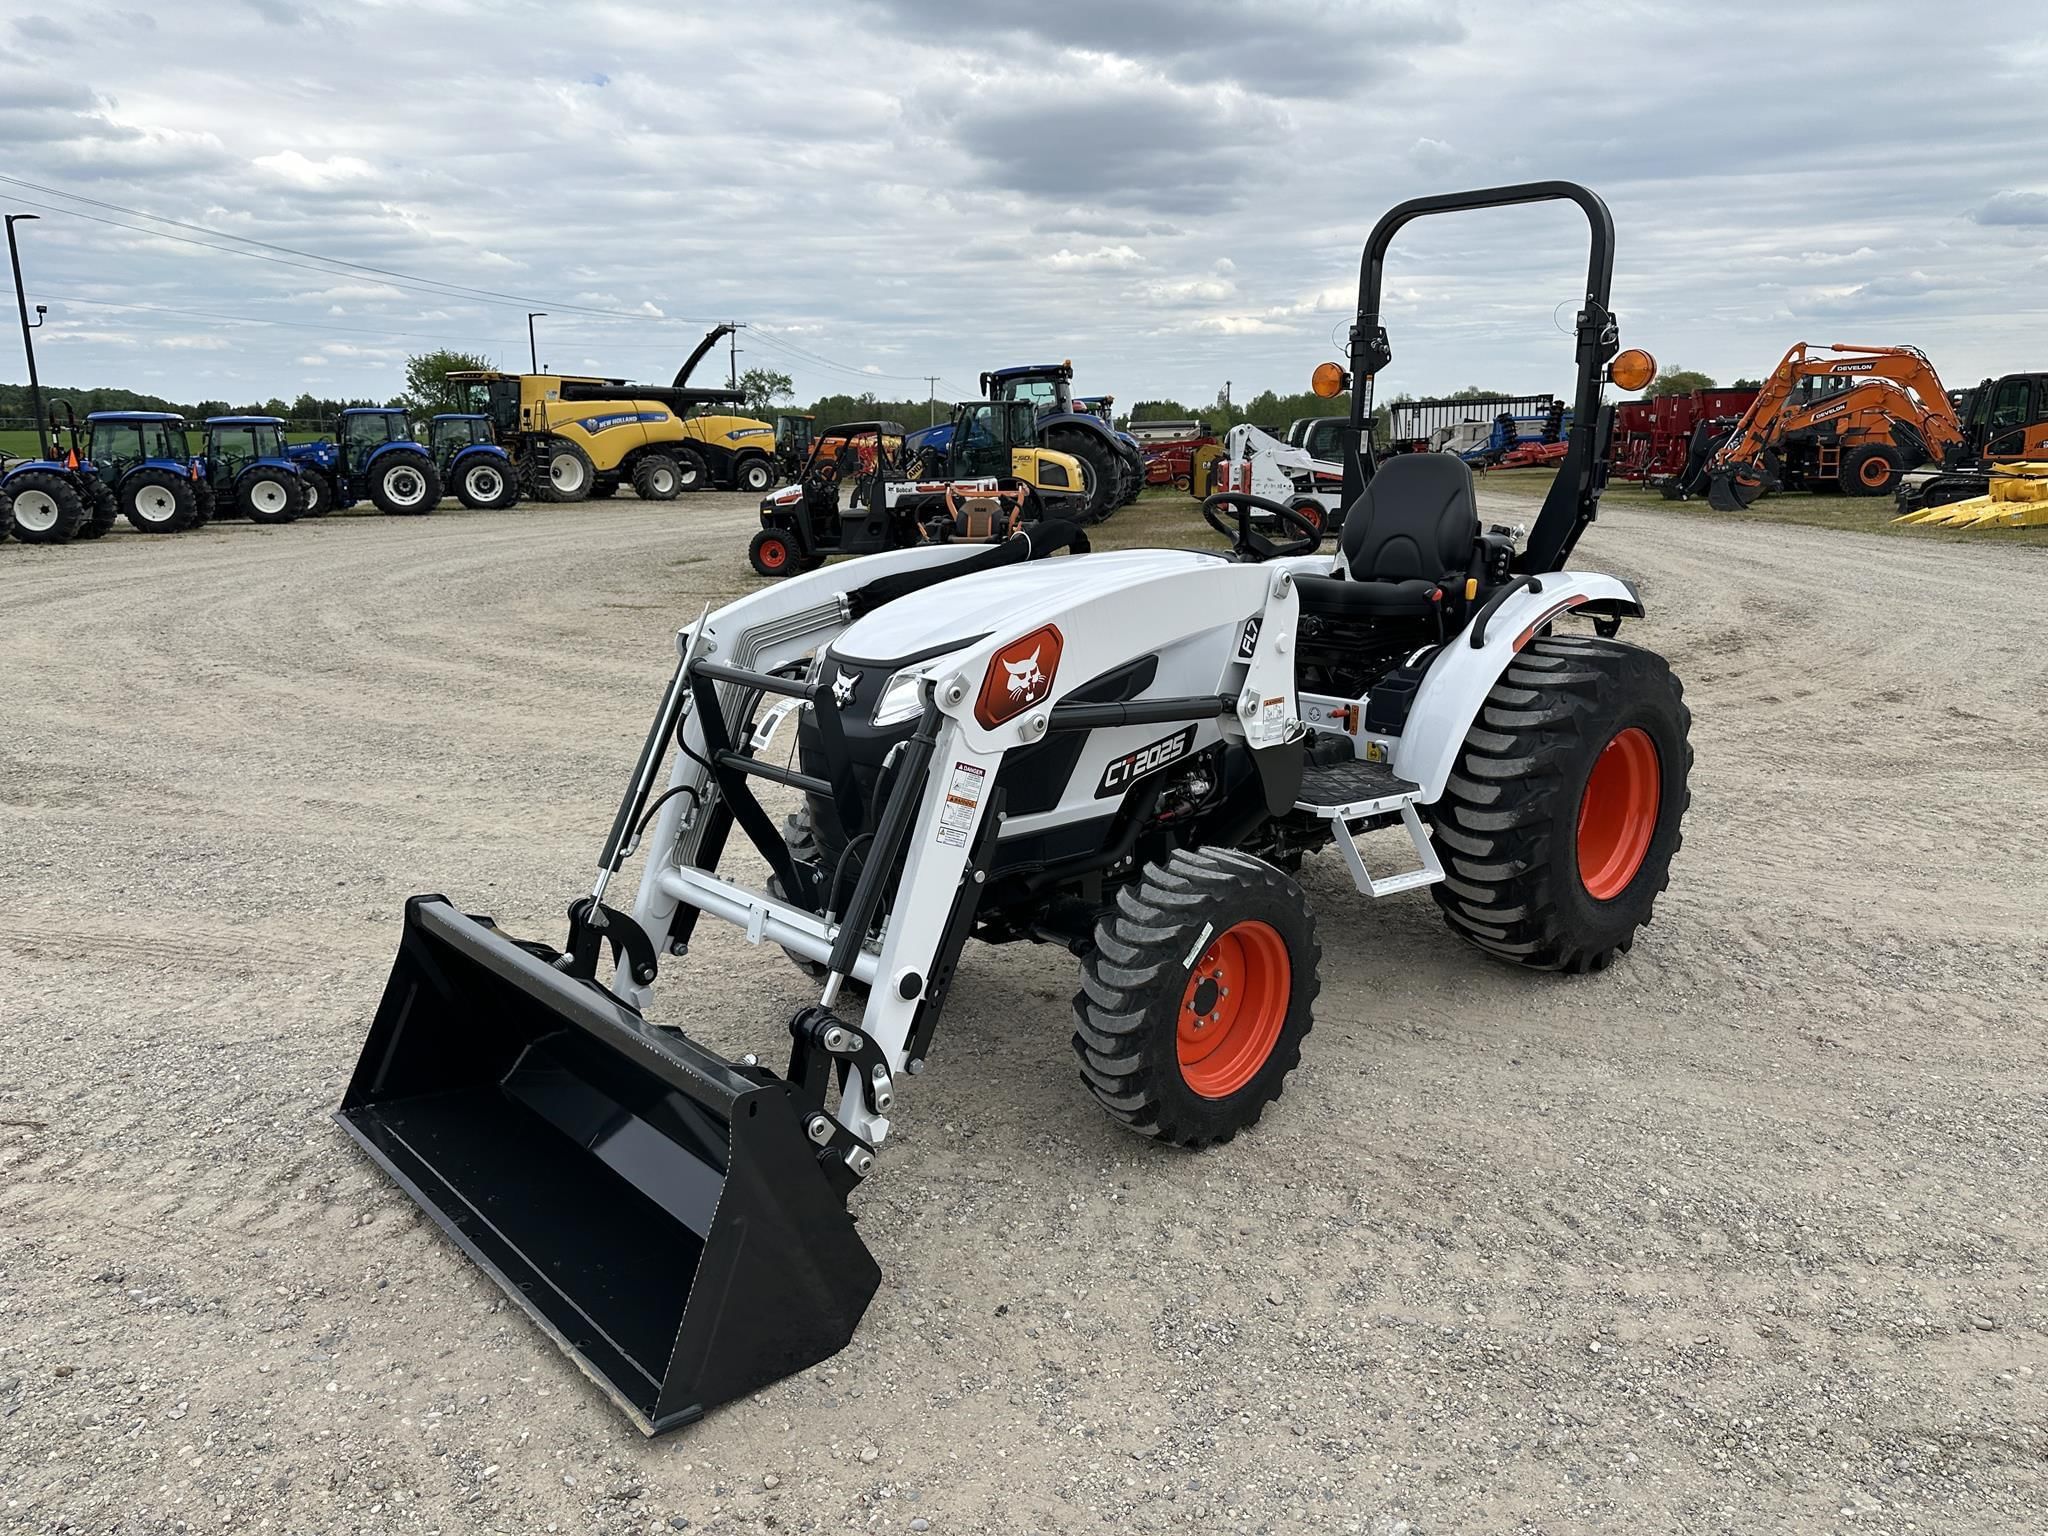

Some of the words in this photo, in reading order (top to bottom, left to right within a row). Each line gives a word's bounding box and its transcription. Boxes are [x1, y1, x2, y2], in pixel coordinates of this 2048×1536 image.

[1816, 404, 1845, 418] DEVELON
[599, 420, 611, 428] NEW
[612, 416, 637, 424] HOLLAND
[1242, 620, 1259, 655] FL7
[1105, 732, 1187, 788] CT2025
[963, 765, 983, 775] DANGER
